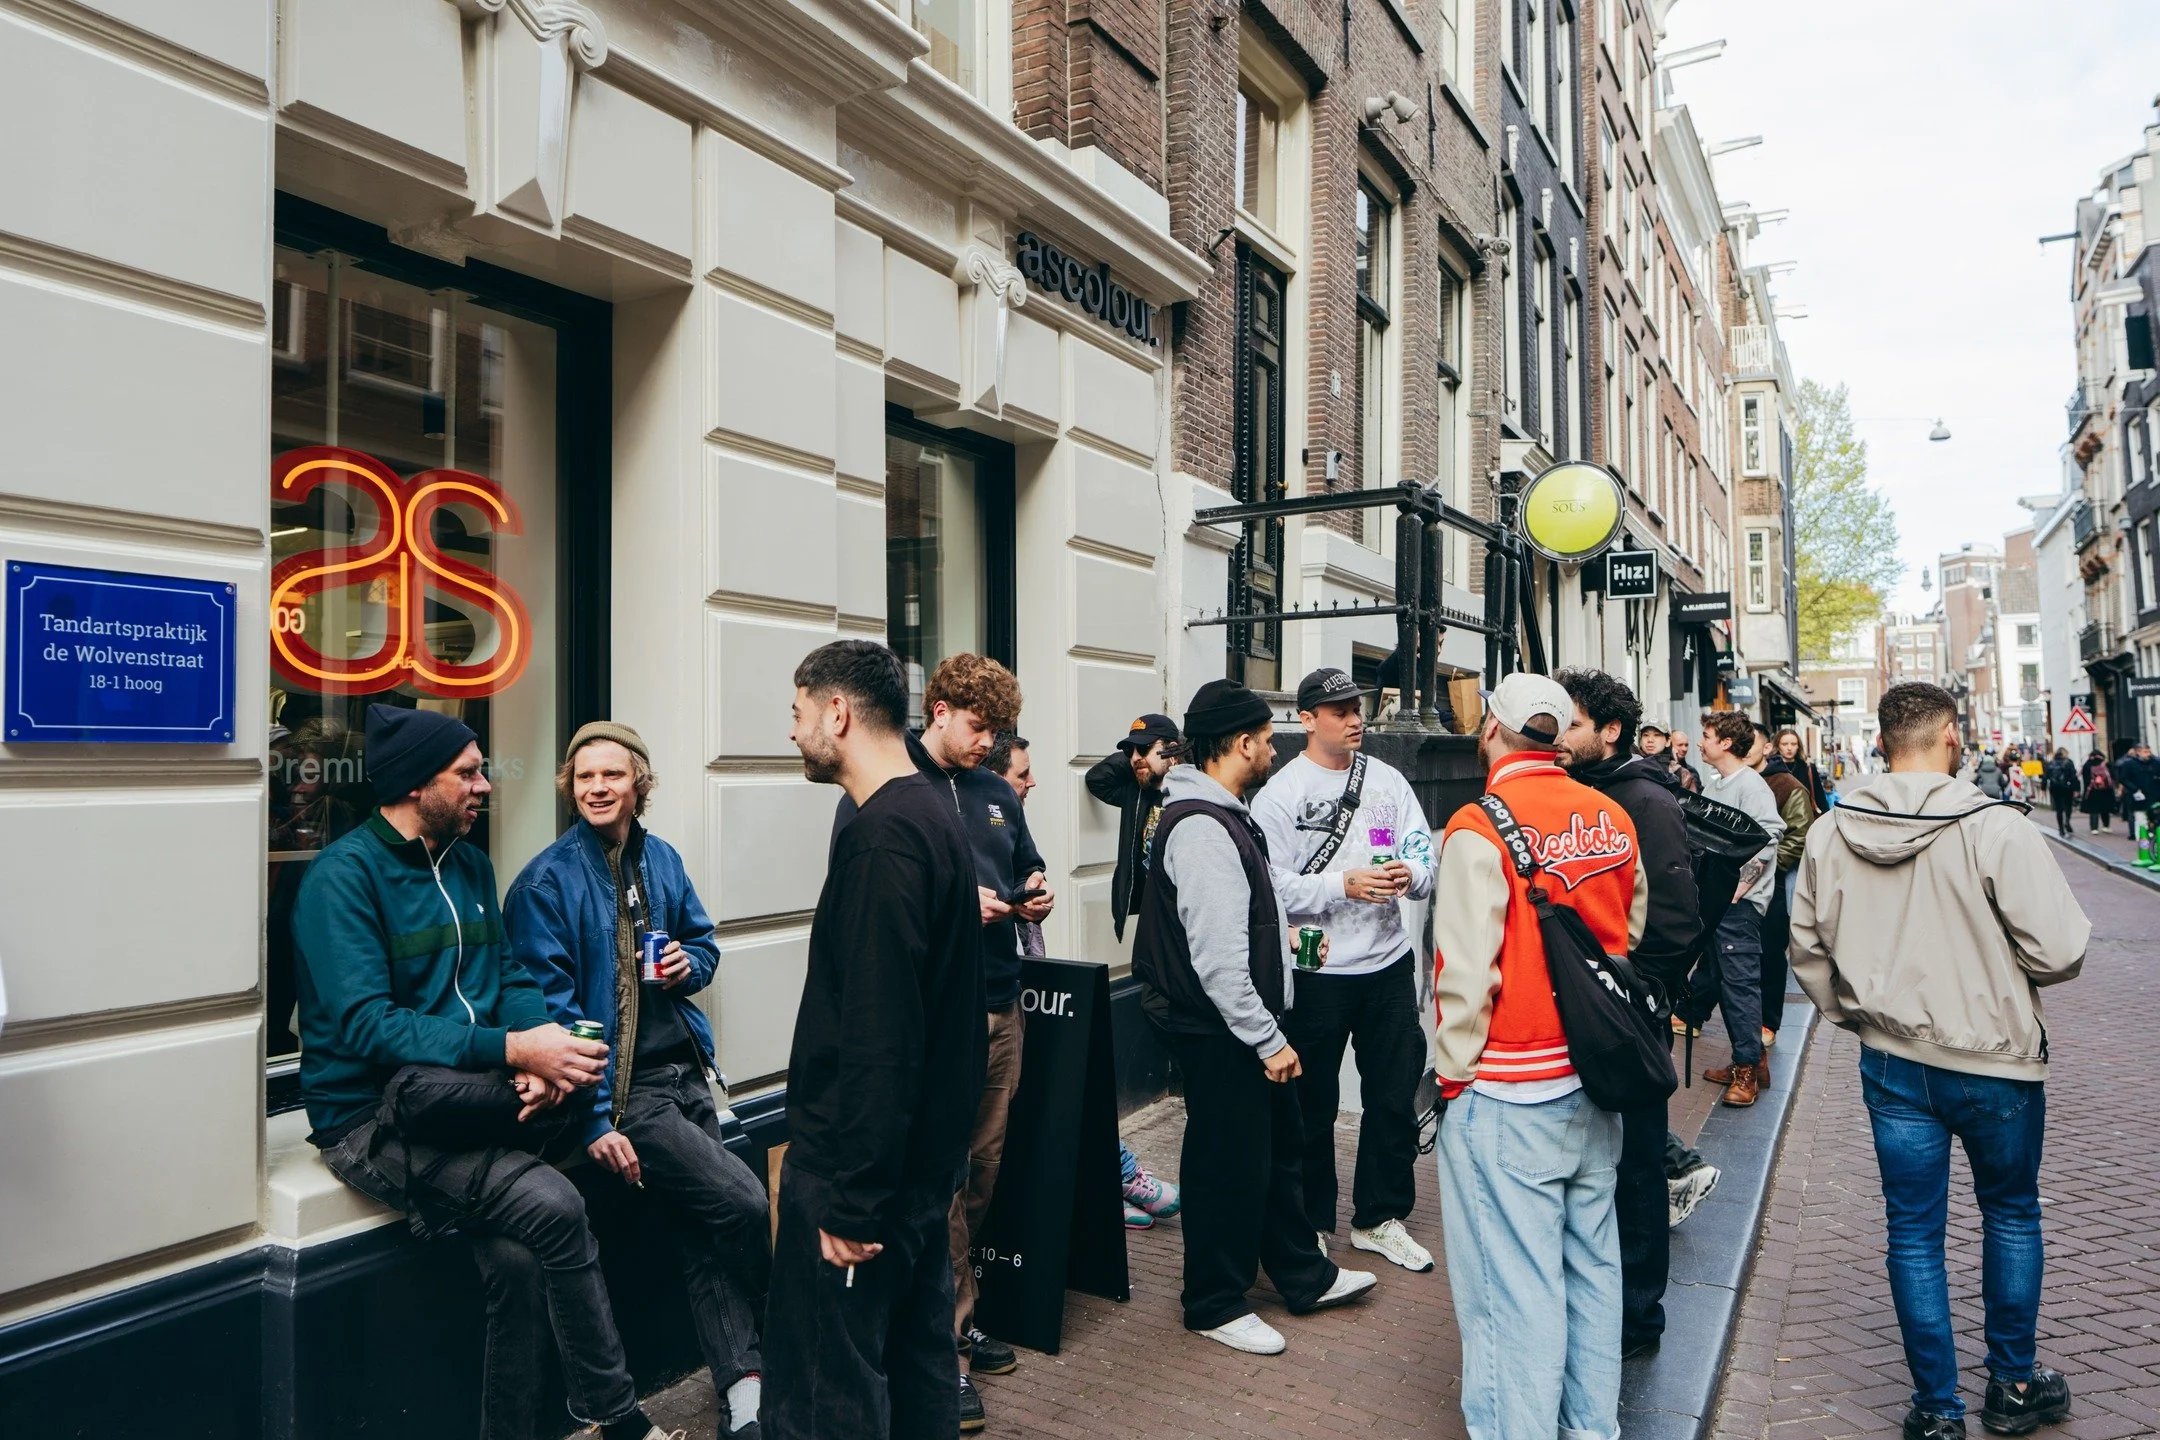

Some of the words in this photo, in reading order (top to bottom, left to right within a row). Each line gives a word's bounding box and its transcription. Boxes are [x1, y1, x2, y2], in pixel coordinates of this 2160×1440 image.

[39, 613, 207, 644] Tandartspraktijk
[43, 643, 68, 661] de
[74, 645, 204, 668] Wolvenstraat
[89, 675, 120, 689] 18-1
[124, 676, 163, 694] hoog
[269, 750, 364, 784] Premi
[1519, 810, 1625, 866] Reebok
[1020, 988, 1074, 1017] our.
[980, 1246, 996, 1261] 10
[1013, 1253, 1022, 1267] 6
